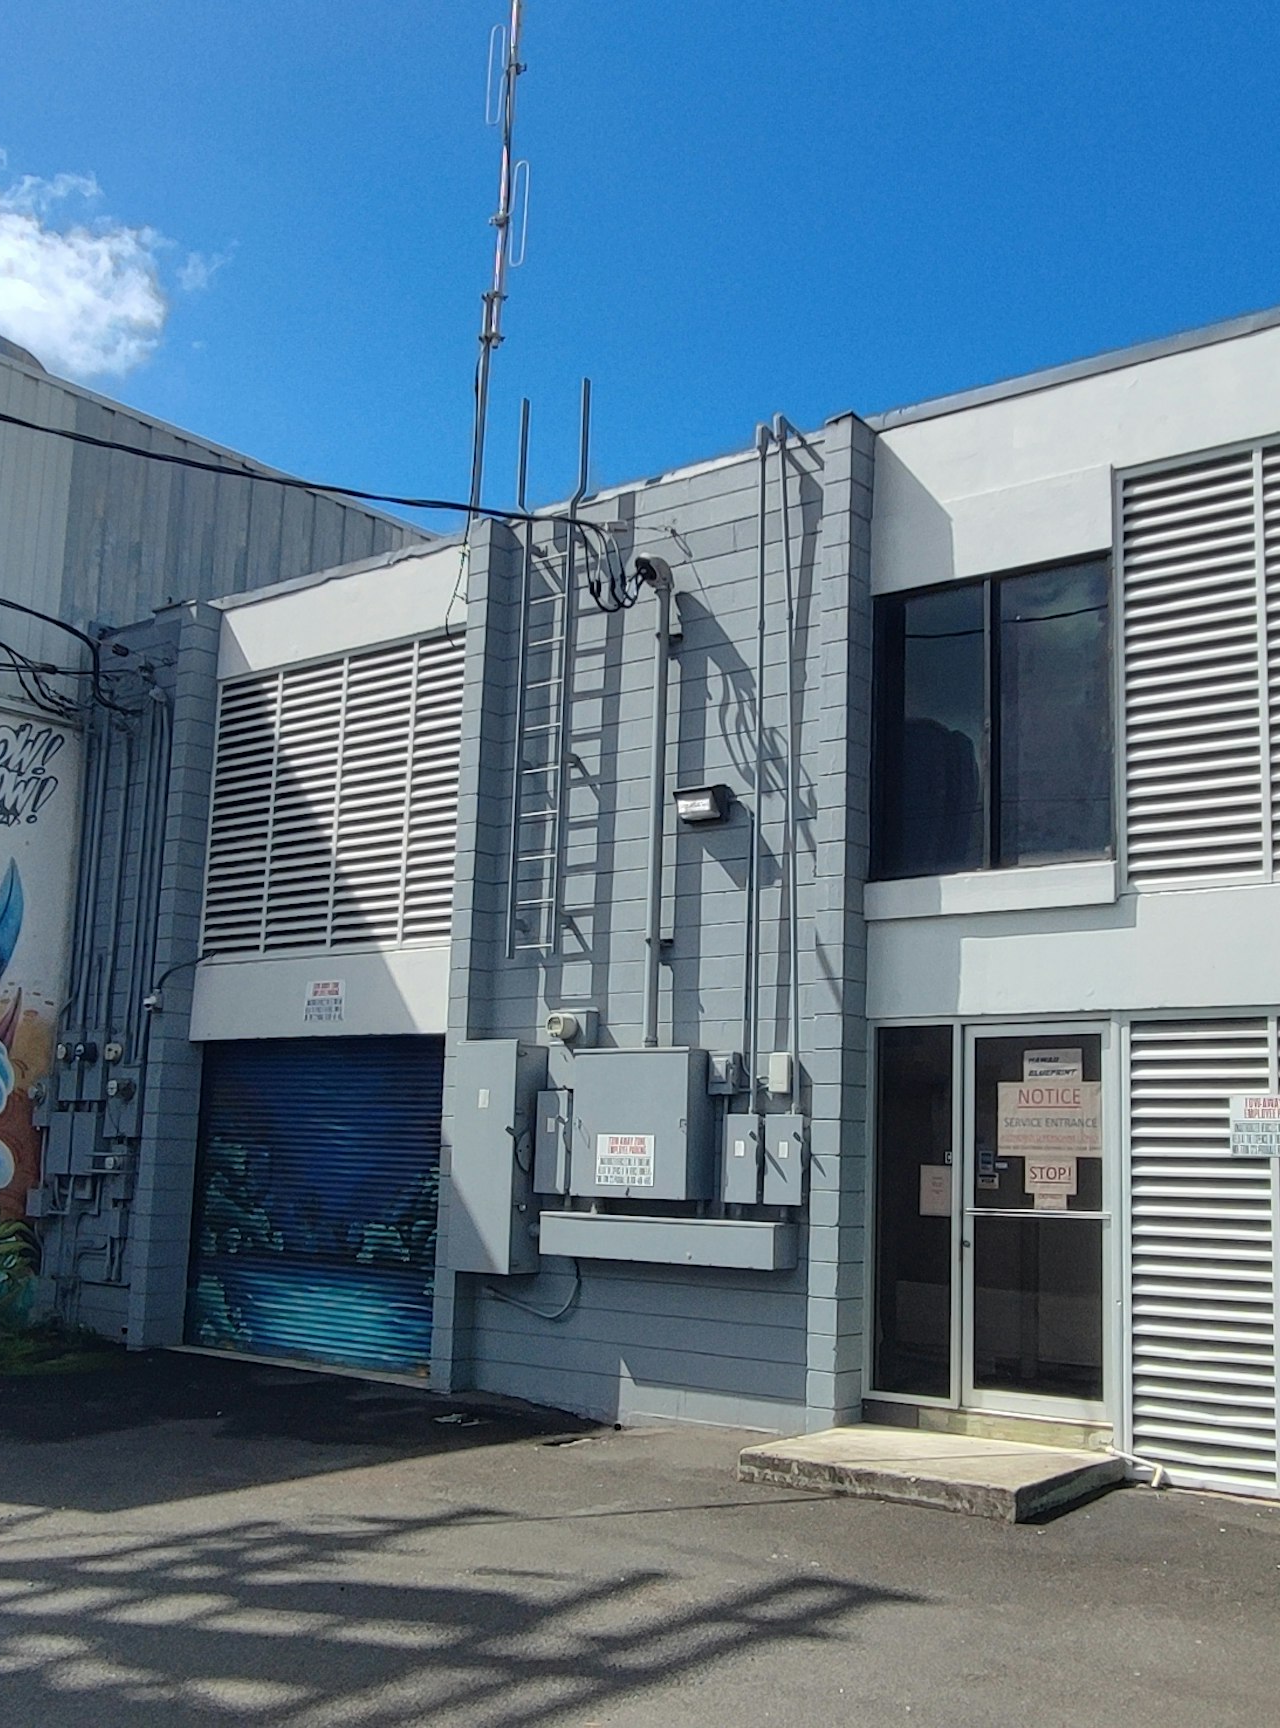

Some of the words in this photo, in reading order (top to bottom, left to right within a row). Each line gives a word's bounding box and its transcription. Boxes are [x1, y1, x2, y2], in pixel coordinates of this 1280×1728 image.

[1018, 1088, 1082, 1105] NOTICE
[1003, 1117, 1042, 1128] SERVICE
[1045, 1117, 1098, 1128] ENTRANCE
[1029, 1166, 1072, 1181] STOP!
